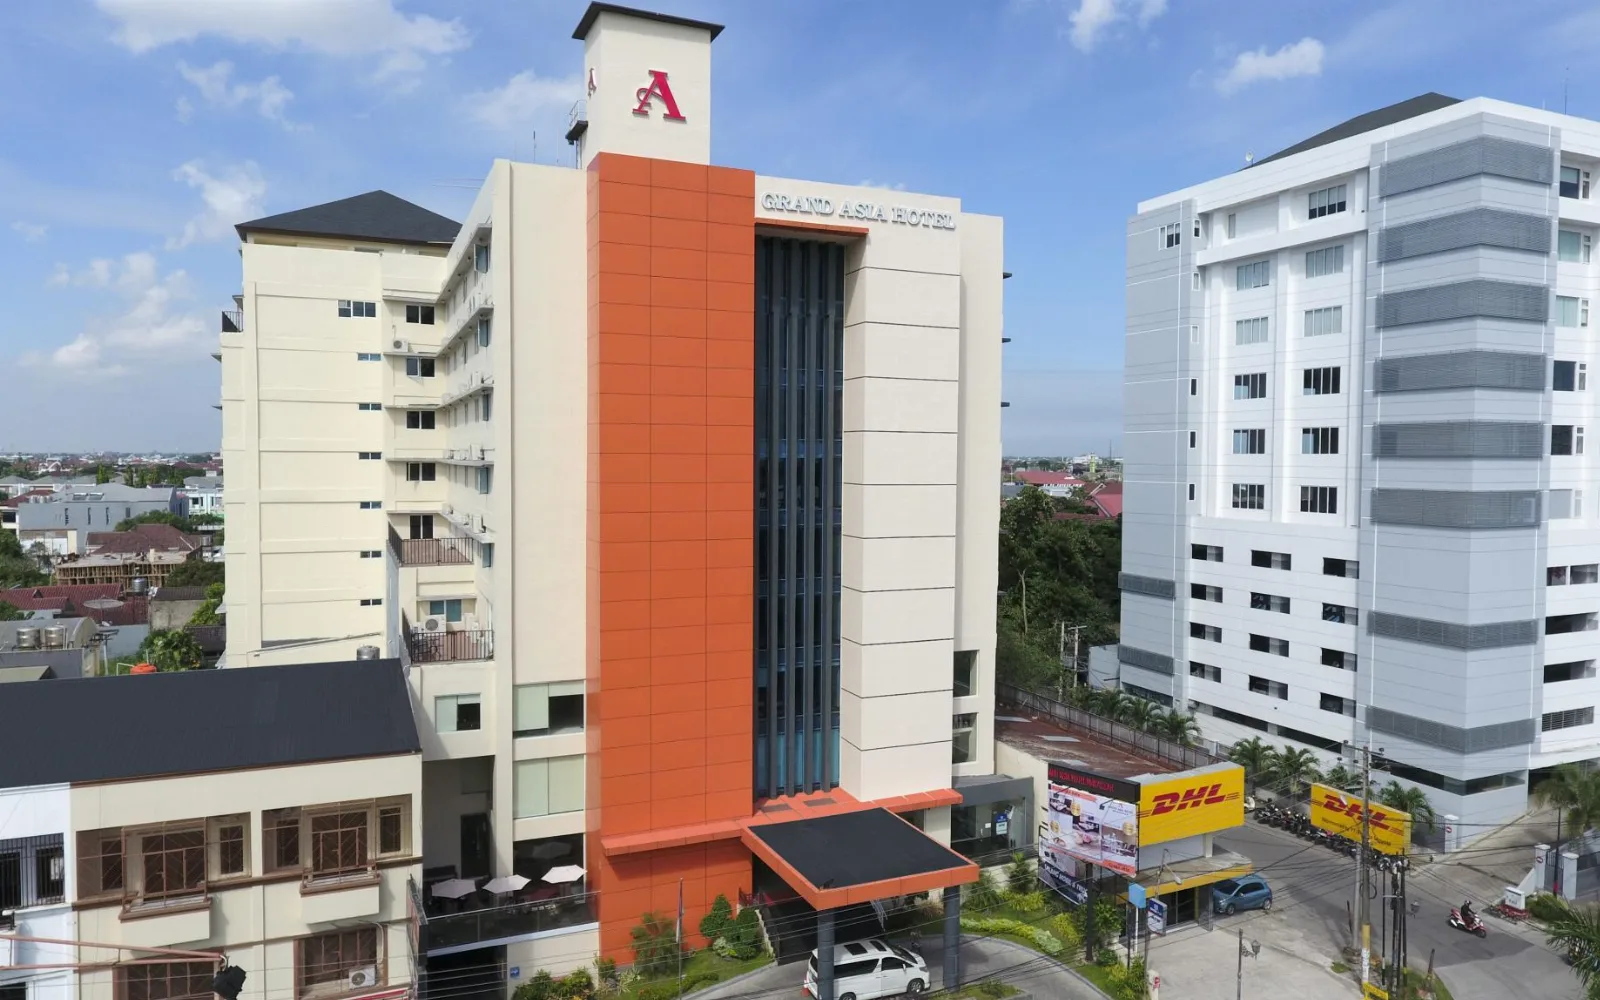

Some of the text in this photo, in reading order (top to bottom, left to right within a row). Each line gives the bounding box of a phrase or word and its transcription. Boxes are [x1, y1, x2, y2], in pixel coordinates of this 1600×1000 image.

[632, 69, 687, 122] A
[761, 191, 956, 229] GRAND ASIA HOTEL
[1150, 783, 1227, 816] DHL
[1323, 794, 1391, 830] DHL
